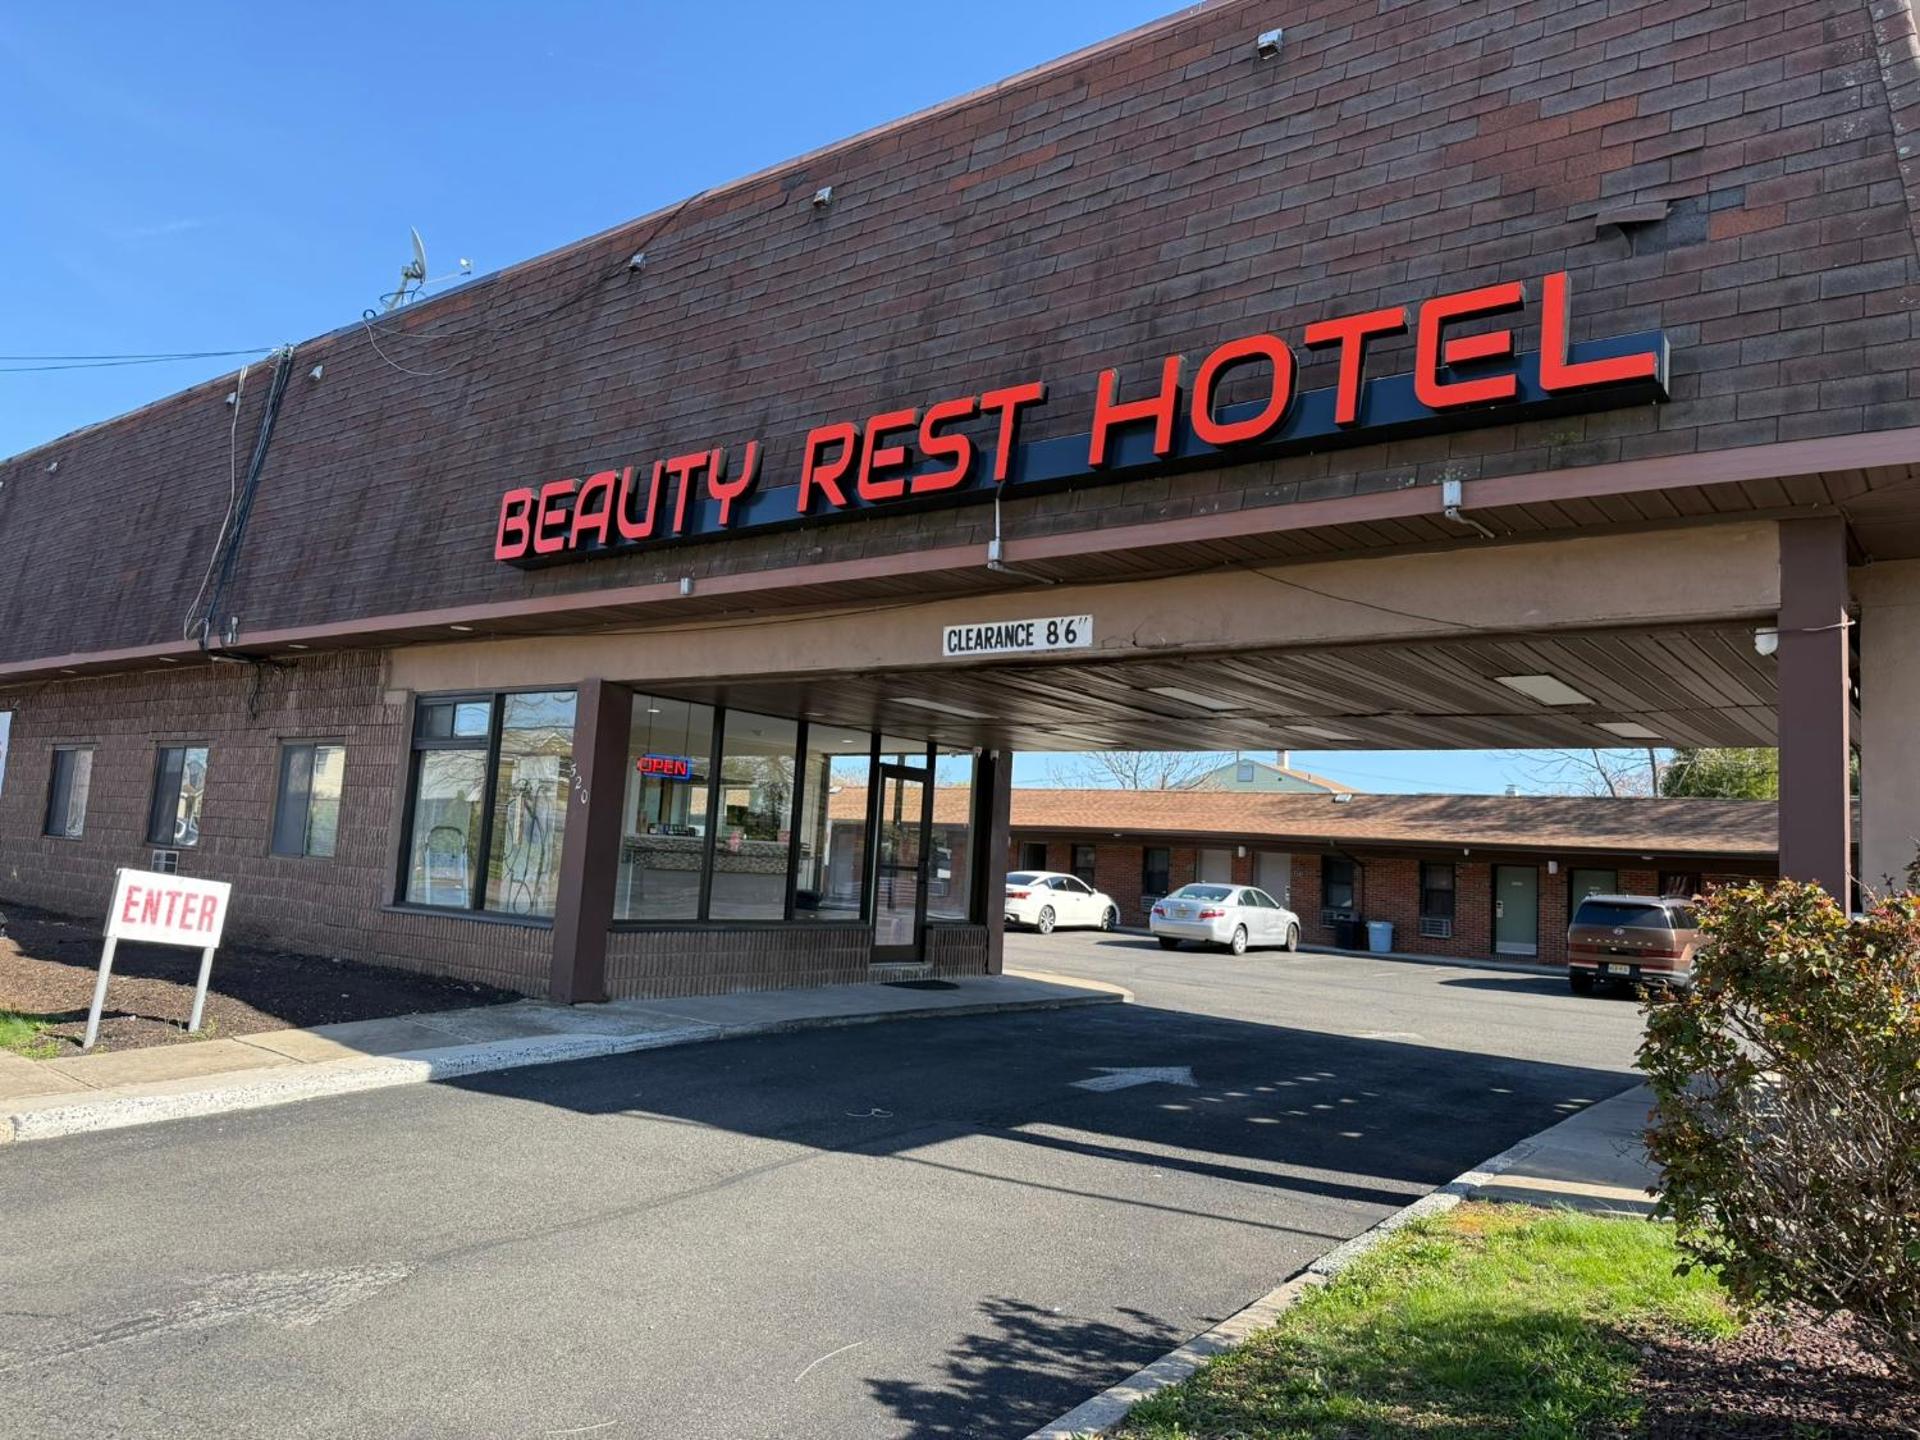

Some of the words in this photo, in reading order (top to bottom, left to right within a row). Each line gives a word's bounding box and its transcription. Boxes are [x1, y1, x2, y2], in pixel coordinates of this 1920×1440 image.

[494, 440, 760, 560] BEAUTY
[796, 381, 1046, 513] REST
[1088, 271, 1658, 469] HOTEL
[947, 623, 1034, 653] CLEARANCE
[637, 757, 688, 776] OPEN
[121, 885, 218, 933] ENTER
